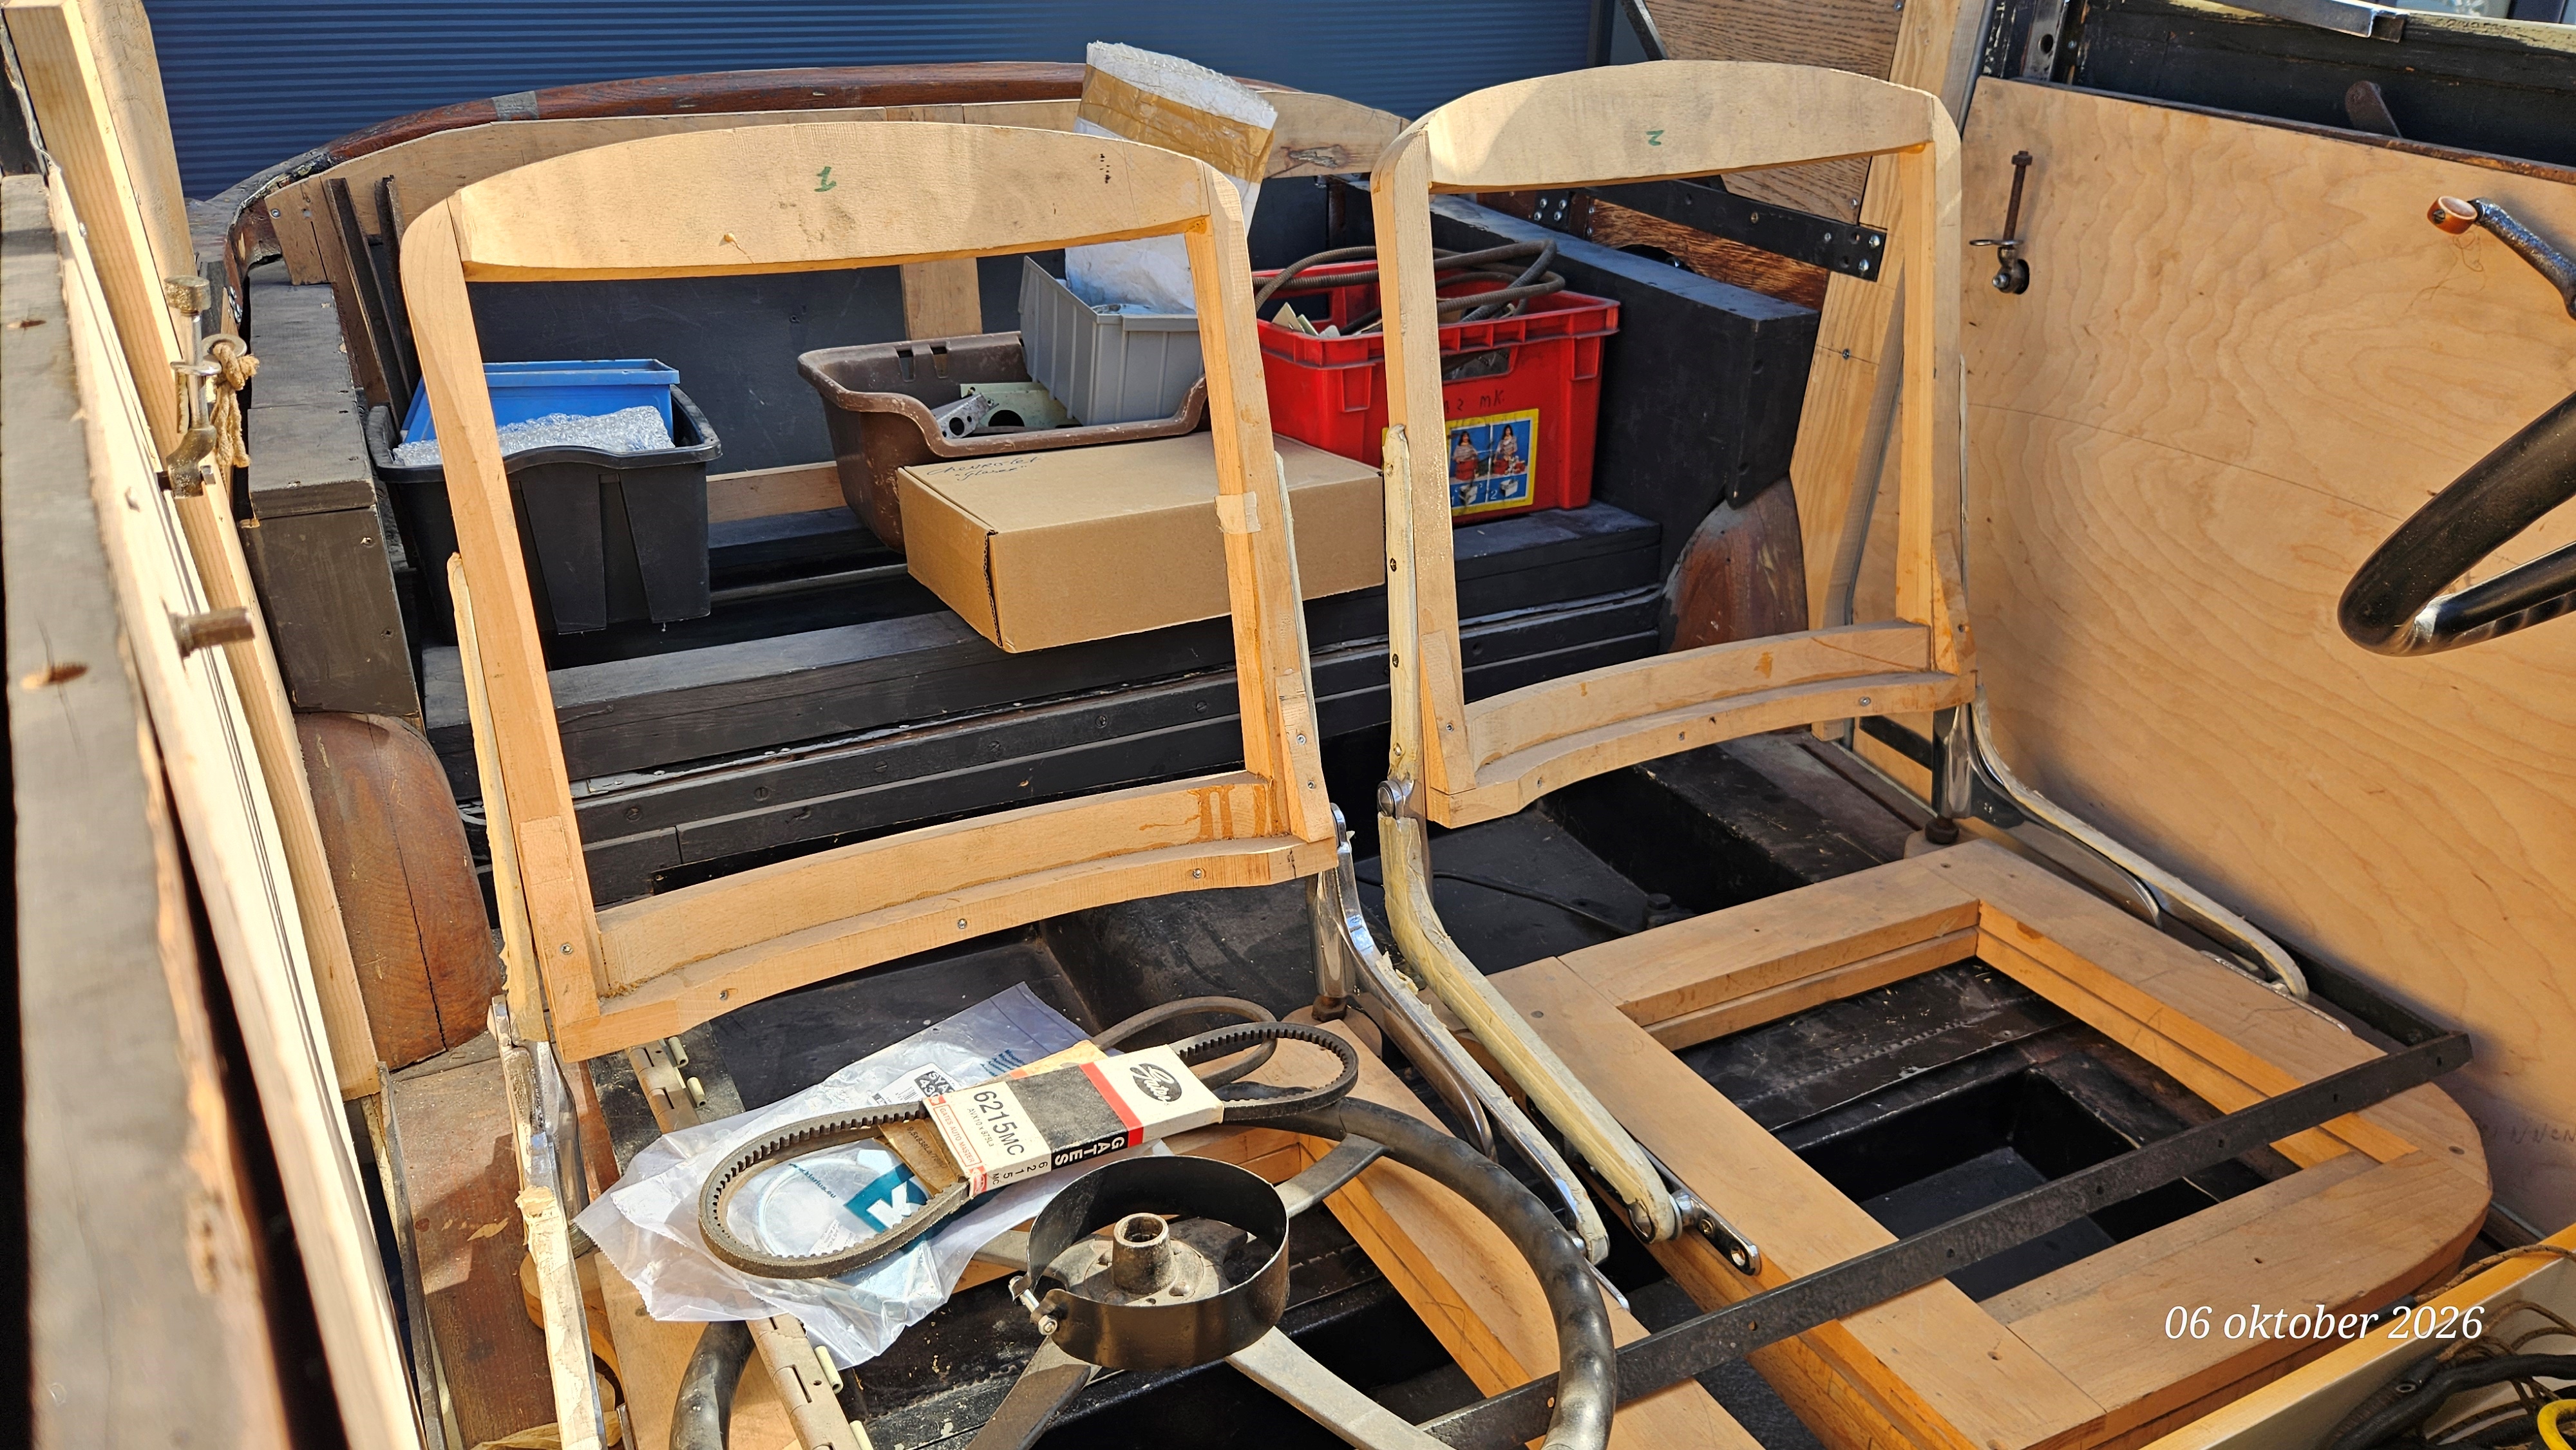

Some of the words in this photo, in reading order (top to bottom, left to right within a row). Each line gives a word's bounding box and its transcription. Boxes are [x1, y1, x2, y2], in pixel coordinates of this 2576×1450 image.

[814, 166, 837, 192] 1
[928, 1072, 954, 1093] SYA
[1130, 1063, 1175, 1102] Gates
[940, 1108, 953, 1125] GATES
[950, 1126, 962, 1141] AUTO
[959, 1141, 975, 1163] MASTER
[974, 1091, 1025, 1155] 6215MC
[1055, 1136, 1125, 1165] GATES
